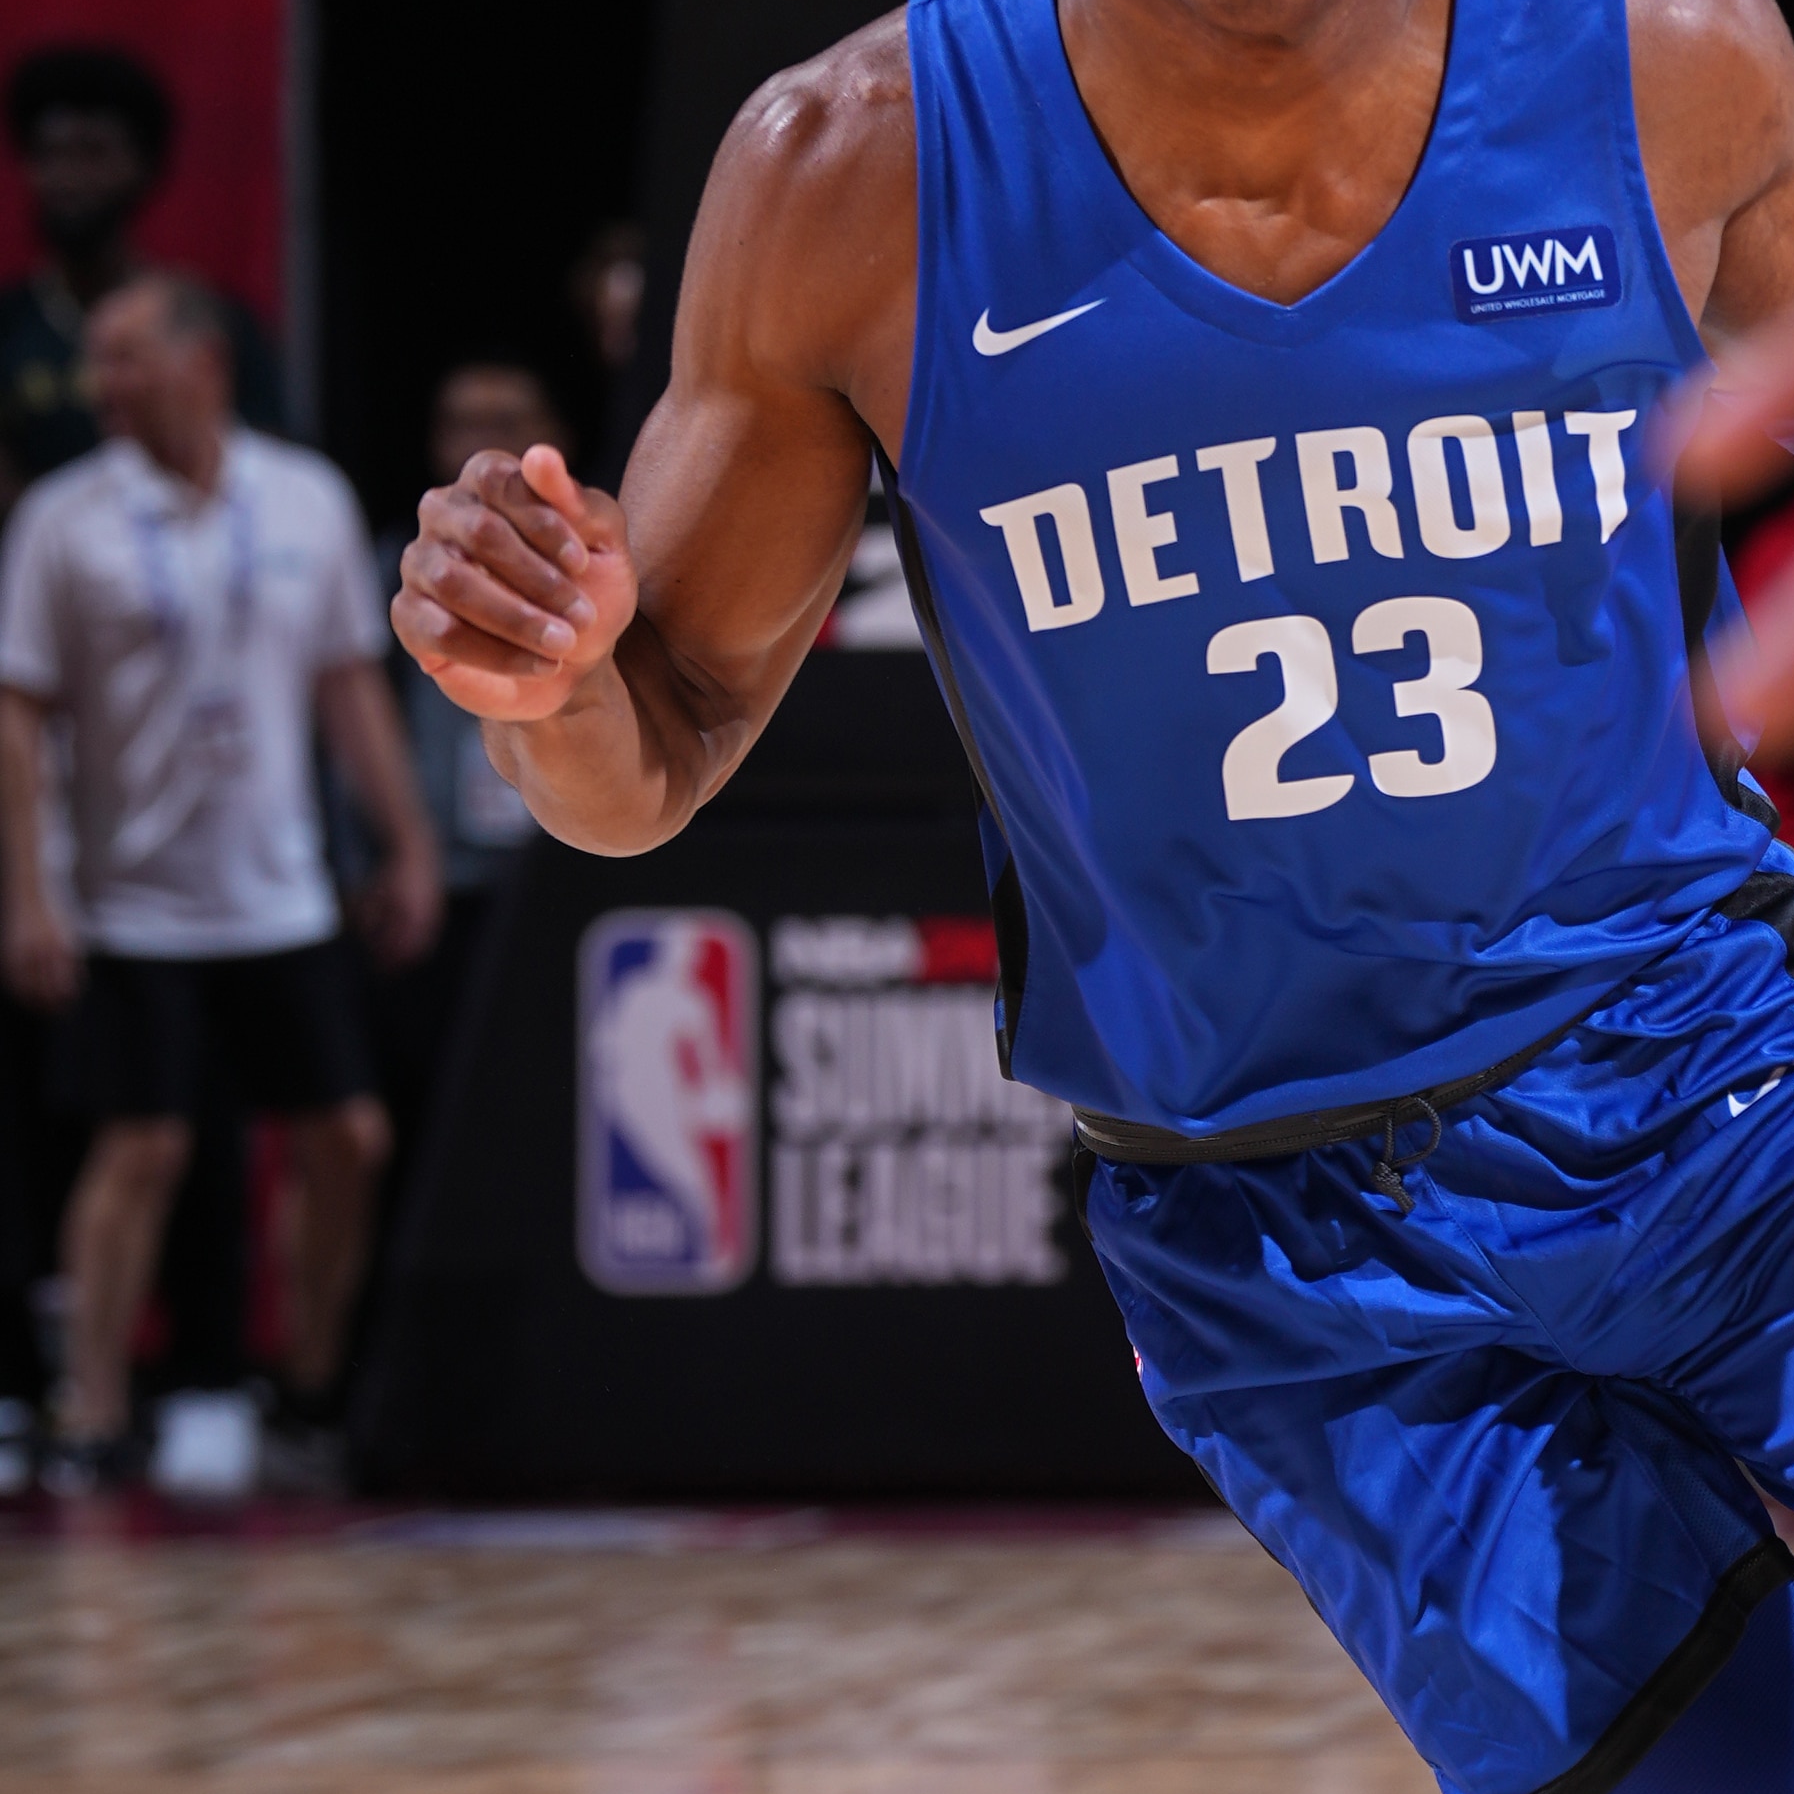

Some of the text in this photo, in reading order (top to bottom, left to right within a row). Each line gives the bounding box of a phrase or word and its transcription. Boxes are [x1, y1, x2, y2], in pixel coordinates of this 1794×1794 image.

[1463, 235, 1604, 295] UWM
[1470, 289, 1606, 314] UNITED WHOLESALE MORTGAGE
[979, 408, 1637, 633] DETROIT
[1206, 595, 1498, 822] 23
